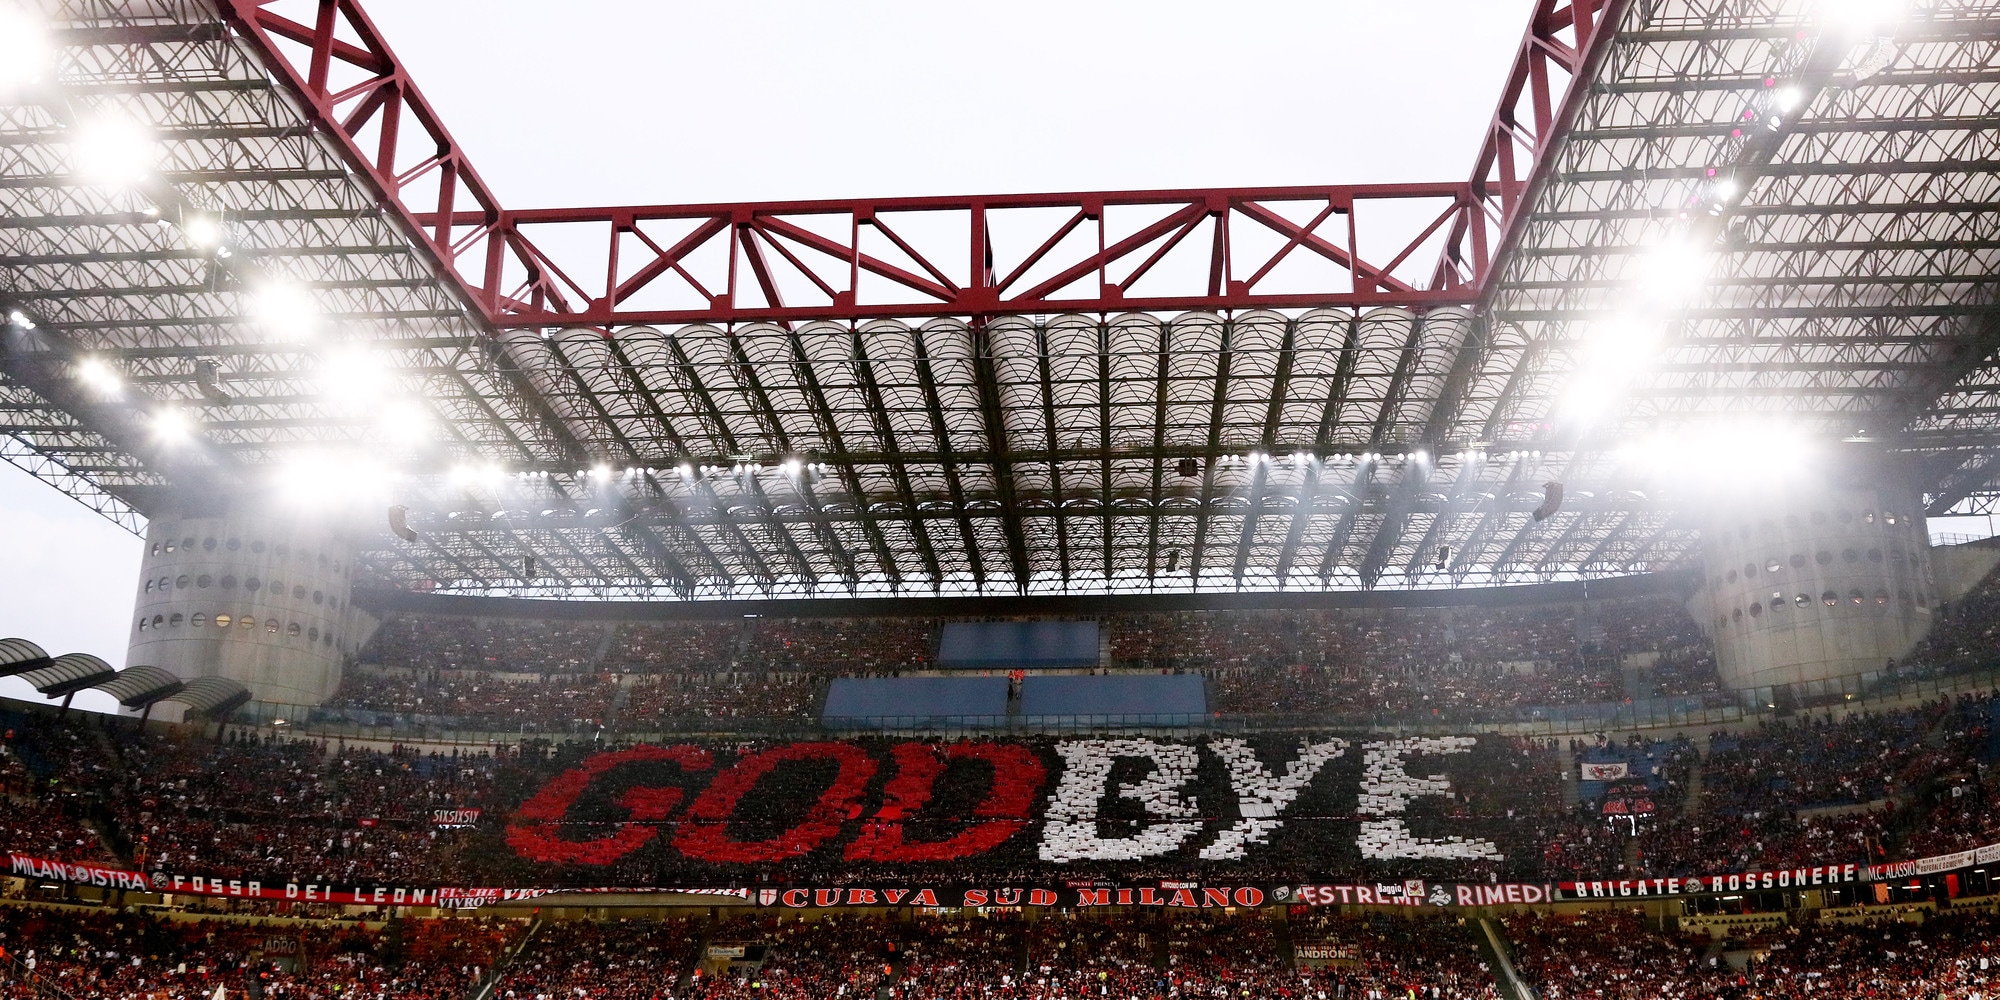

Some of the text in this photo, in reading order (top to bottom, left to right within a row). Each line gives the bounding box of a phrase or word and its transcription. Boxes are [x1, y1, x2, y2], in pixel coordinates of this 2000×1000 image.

[10, 854, 146, 891] MILAN ISTRA
[1574, 863, 1856, 898] BRIGATE ROSSONERE
[1885, 861, 1916, 879] ALASSIO
[173, 874, 438, 904] FOSSA DEI LEONI
[781, 886, 1265, 908] CURVA SUD MILANO
[1377, 883, 1402, 895] Baggio
[1456, 884, 1553, 907] RIMEDI
